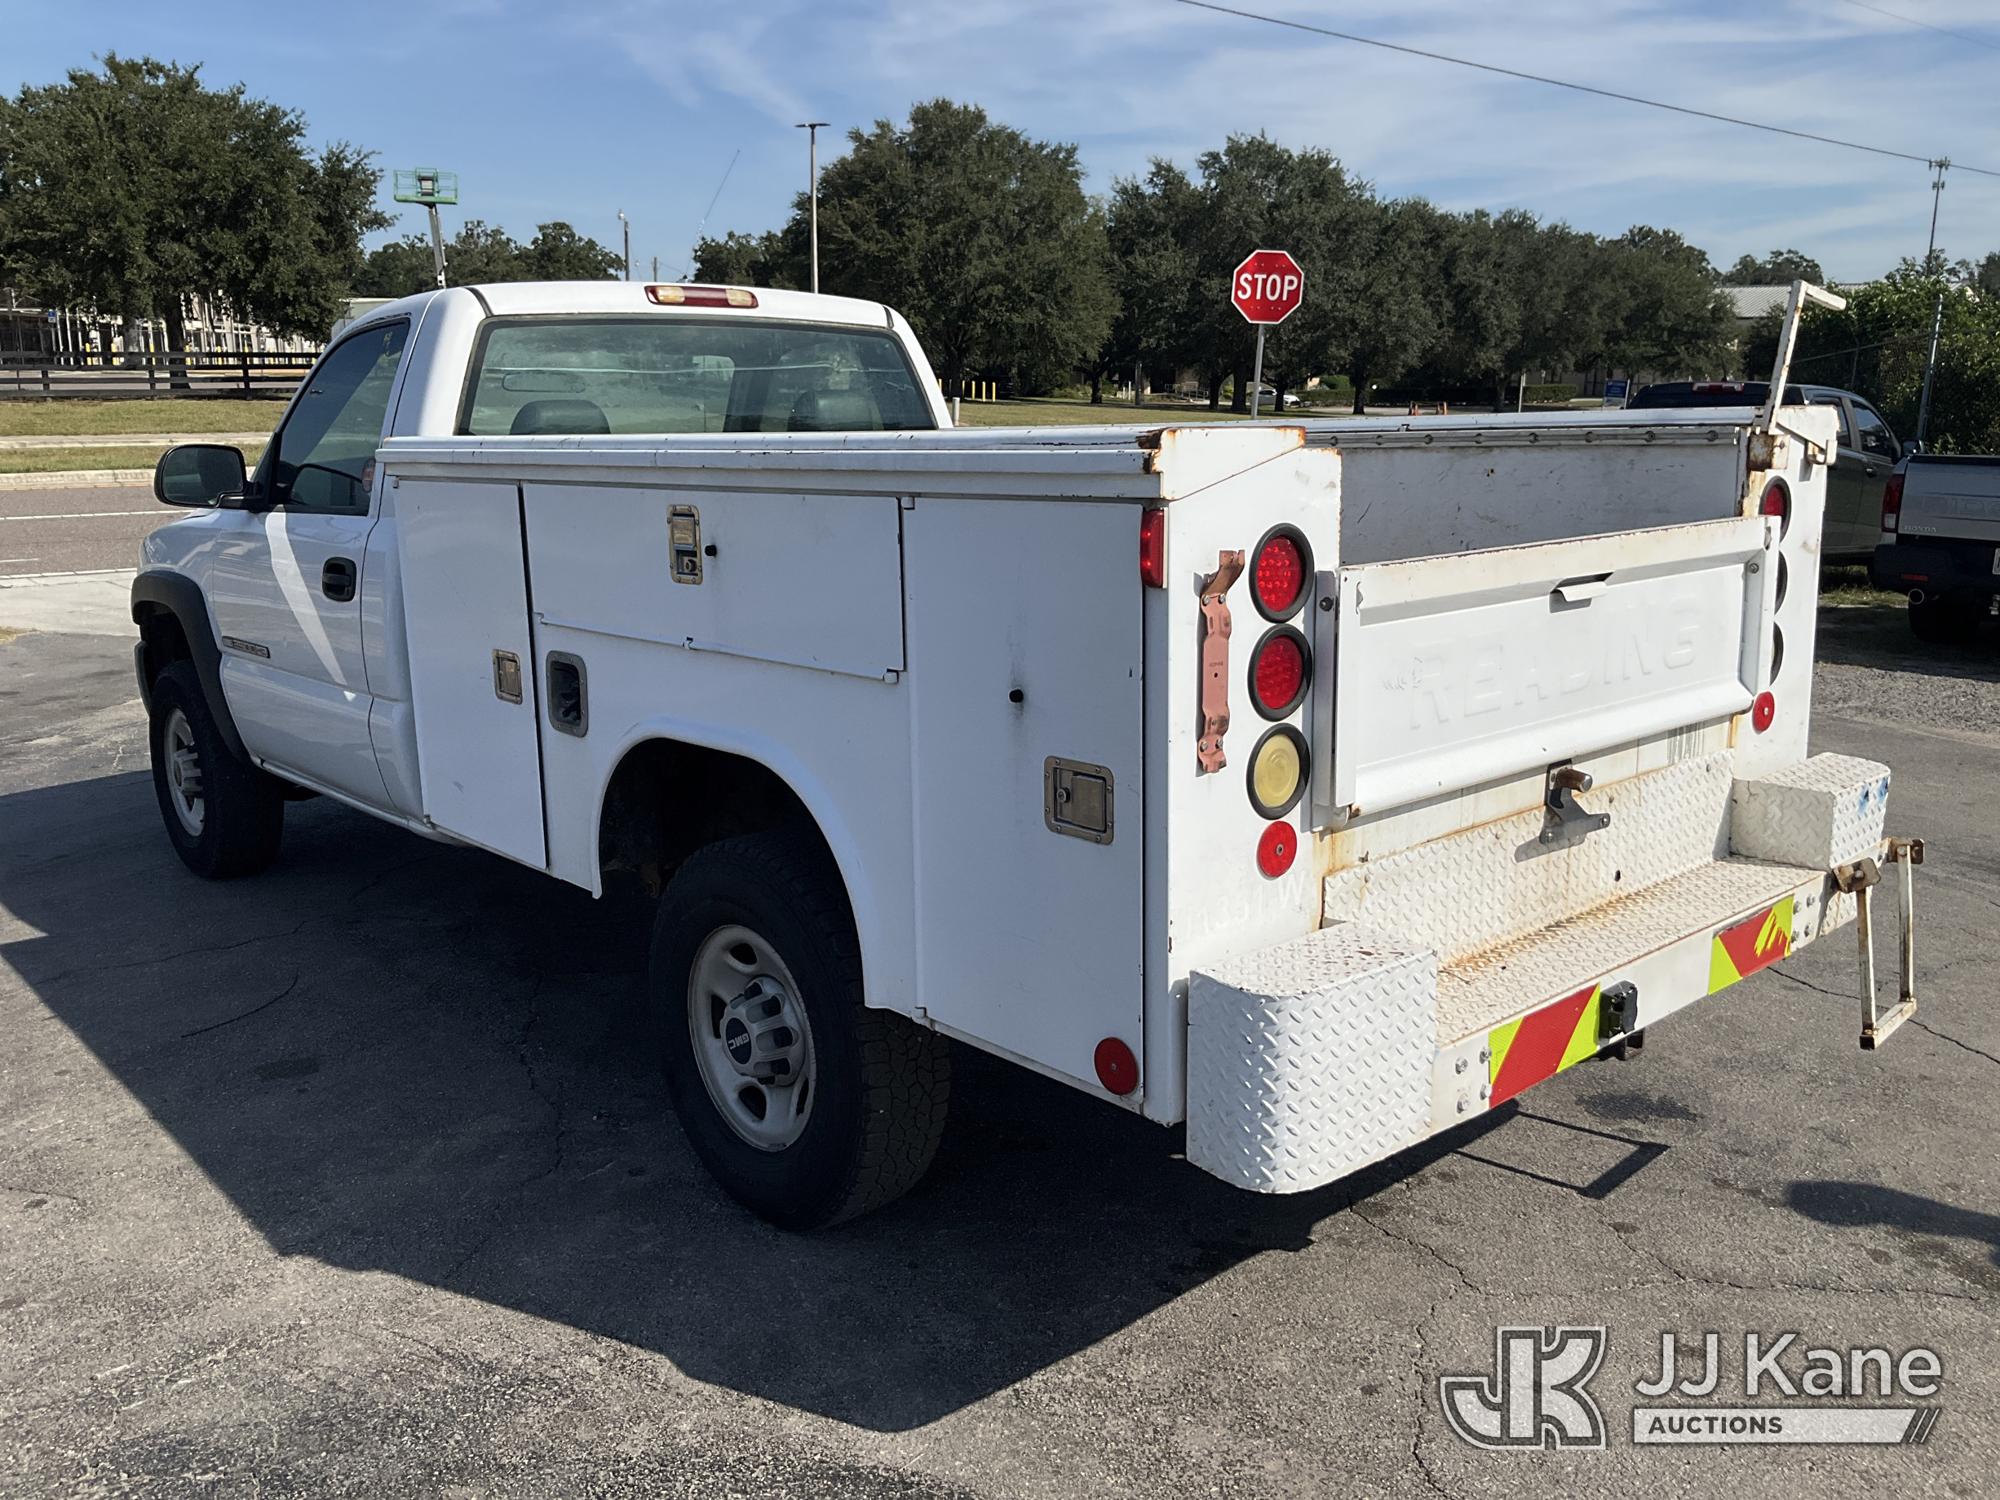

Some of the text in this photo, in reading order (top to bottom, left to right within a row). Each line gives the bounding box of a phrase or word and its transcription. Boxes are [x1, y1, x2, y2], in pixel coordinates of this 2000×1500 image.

[1237, 272, 1299, 301] STOP
[1406, 592, 1702, 732] READING
[728, 1032, 750, 1050] GMC
